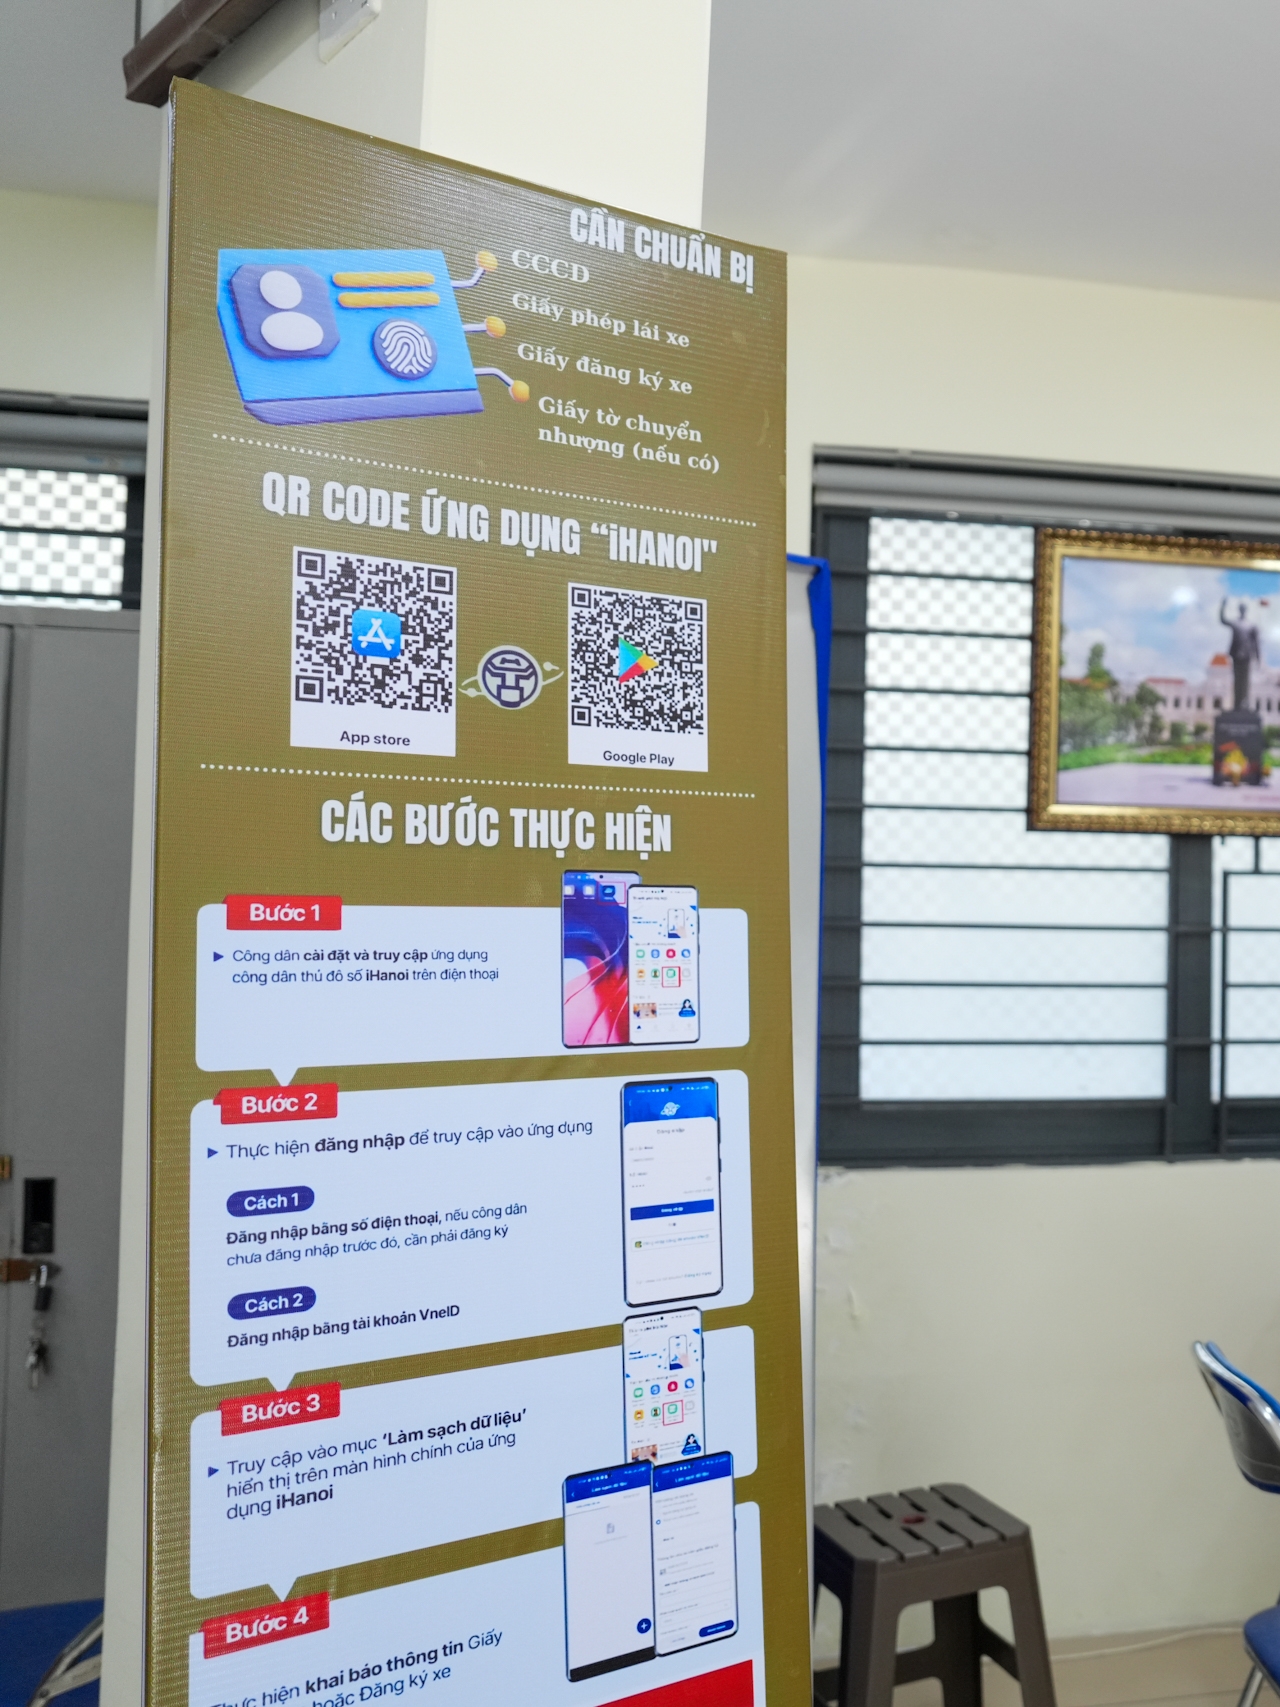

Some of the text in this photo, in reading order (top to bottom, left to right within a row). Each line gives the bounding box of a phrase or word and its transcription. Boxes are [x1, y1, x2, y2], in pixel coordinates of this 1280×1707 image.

[512, 249, 590, 283] CCCD
[570, 207, 753, 294] CẦN CHUẨN BỊ
[512, 293, 690, 348] Giấy phép lái xe
[517, 343, 693, 395] Giấy đăng ký xe
[538, 396, 702, 443] Giấy tờ chuyển
[538, 426, 720, 474] nhượng (nếu có)
[263, 471, 311, 516] QR
[323, 481, 410, 531] CODE
[422, 488, 489, 543] ỨNG
[501, 508, 580, 557] DỤNG
[340, 730, 411, 747] App store
[603, 750, 675, 766] Google Play
[321, 790, 672, 860] CÁC BƯỚC THỰC HIỆN
[249, 903, 320, 922] Bước 1
[232, 949, 488, 965] Công dân cài đặt và truy cập ứng dụng
[232, 970, 268, 986] công
[271, 970, 297, 983] dân
[326, 970, 343, 982] đô
[347, 968, 363, 982] số
[366, 969, 409, 981] iHanoi
[412, 968, 437, 980] trên
[440, 968, 466, 982] điện
[469, 967, 499, 982] thoại
[241, 1093, 318, 1114] Bước 2
[226, 1143, 270, 1160] Thực
[275, 1140, 310, 1157] hiện
[314, 1137, 358, 1153] đăng
[362, 1133, 405, 1150] nhập
[433, 1131, 462, 1145] truy
[466, 1127, 494, 1143] cập
[498, 1125, 523, 1139] vào
[527, 1123, 554, 1138] ứng
[557, 1121, 593, 1136] dụng
[243, 1192, 299, 1211] Cách 1
[226, 1230, 267, 1245] Đăng
[270, 1225, 308, 1241] nhập
[351, 1217, 369, 1232] số
[371, 1216, 401, 1231] điện
[404, 1211, 442, 1227] thoại,
[445, 1208, 469, 1221] nếu
[471, 1206, 502, 1219] công
[505, 1203, 527, 1215] dân
[226, 1224, 509, 1266] chưa đăng nhập trước đó, cần phải đăng ký
[245, 1293, 303, 1313] Cách 2
[227, 1333, 268, 1348] Đăng
[272, 1326, 310, 1342] nhập
[353, 1316, 371, 1330] tài
[373, 1311, 416, 1328] khoản
[419, 1305, 460, 1320] VneID
[242, 1393, 320, 1423] Bước 3
[227, 1458, 266, 1476] Truy
[271, 1450, 302, 1468] cập
[307, 1445, 337, 1460] vào
[342, 1437, 377, 1454] mục
[427, 1420, 466, 1440] sạch
[470, 1414, 492, 1430] dữ
[269, 1474, 290, 1490] thị
[295, 1467, 328, 1484] trên
[333, 1461, 368, 1477] màn
[373, 1452, 406, 1469] hình
[411, 1444, 452, 1462] chính
[457, 1437, 484, 1453] của
[488, 1433, 516, 1448] ứng
[226, 1484, 333, 1520] dụng iHanoi
[226, 1607, 309, 1643] Bước 4
[262, 1686, 300, 1706] hiện
[305, 1670, 344, 1694] khai
[348, 1663, 382, 1683] báo
[386, 1649, 439, 1673] thông
[442, 1641, 464, 1657] tin
[468, 1628, 503, 1650] Giấy
[360, 1679, 404, 1702] Đăng
[409, 1670, 428, 1689] ký
[433, 1666, 451, 1682] xe
